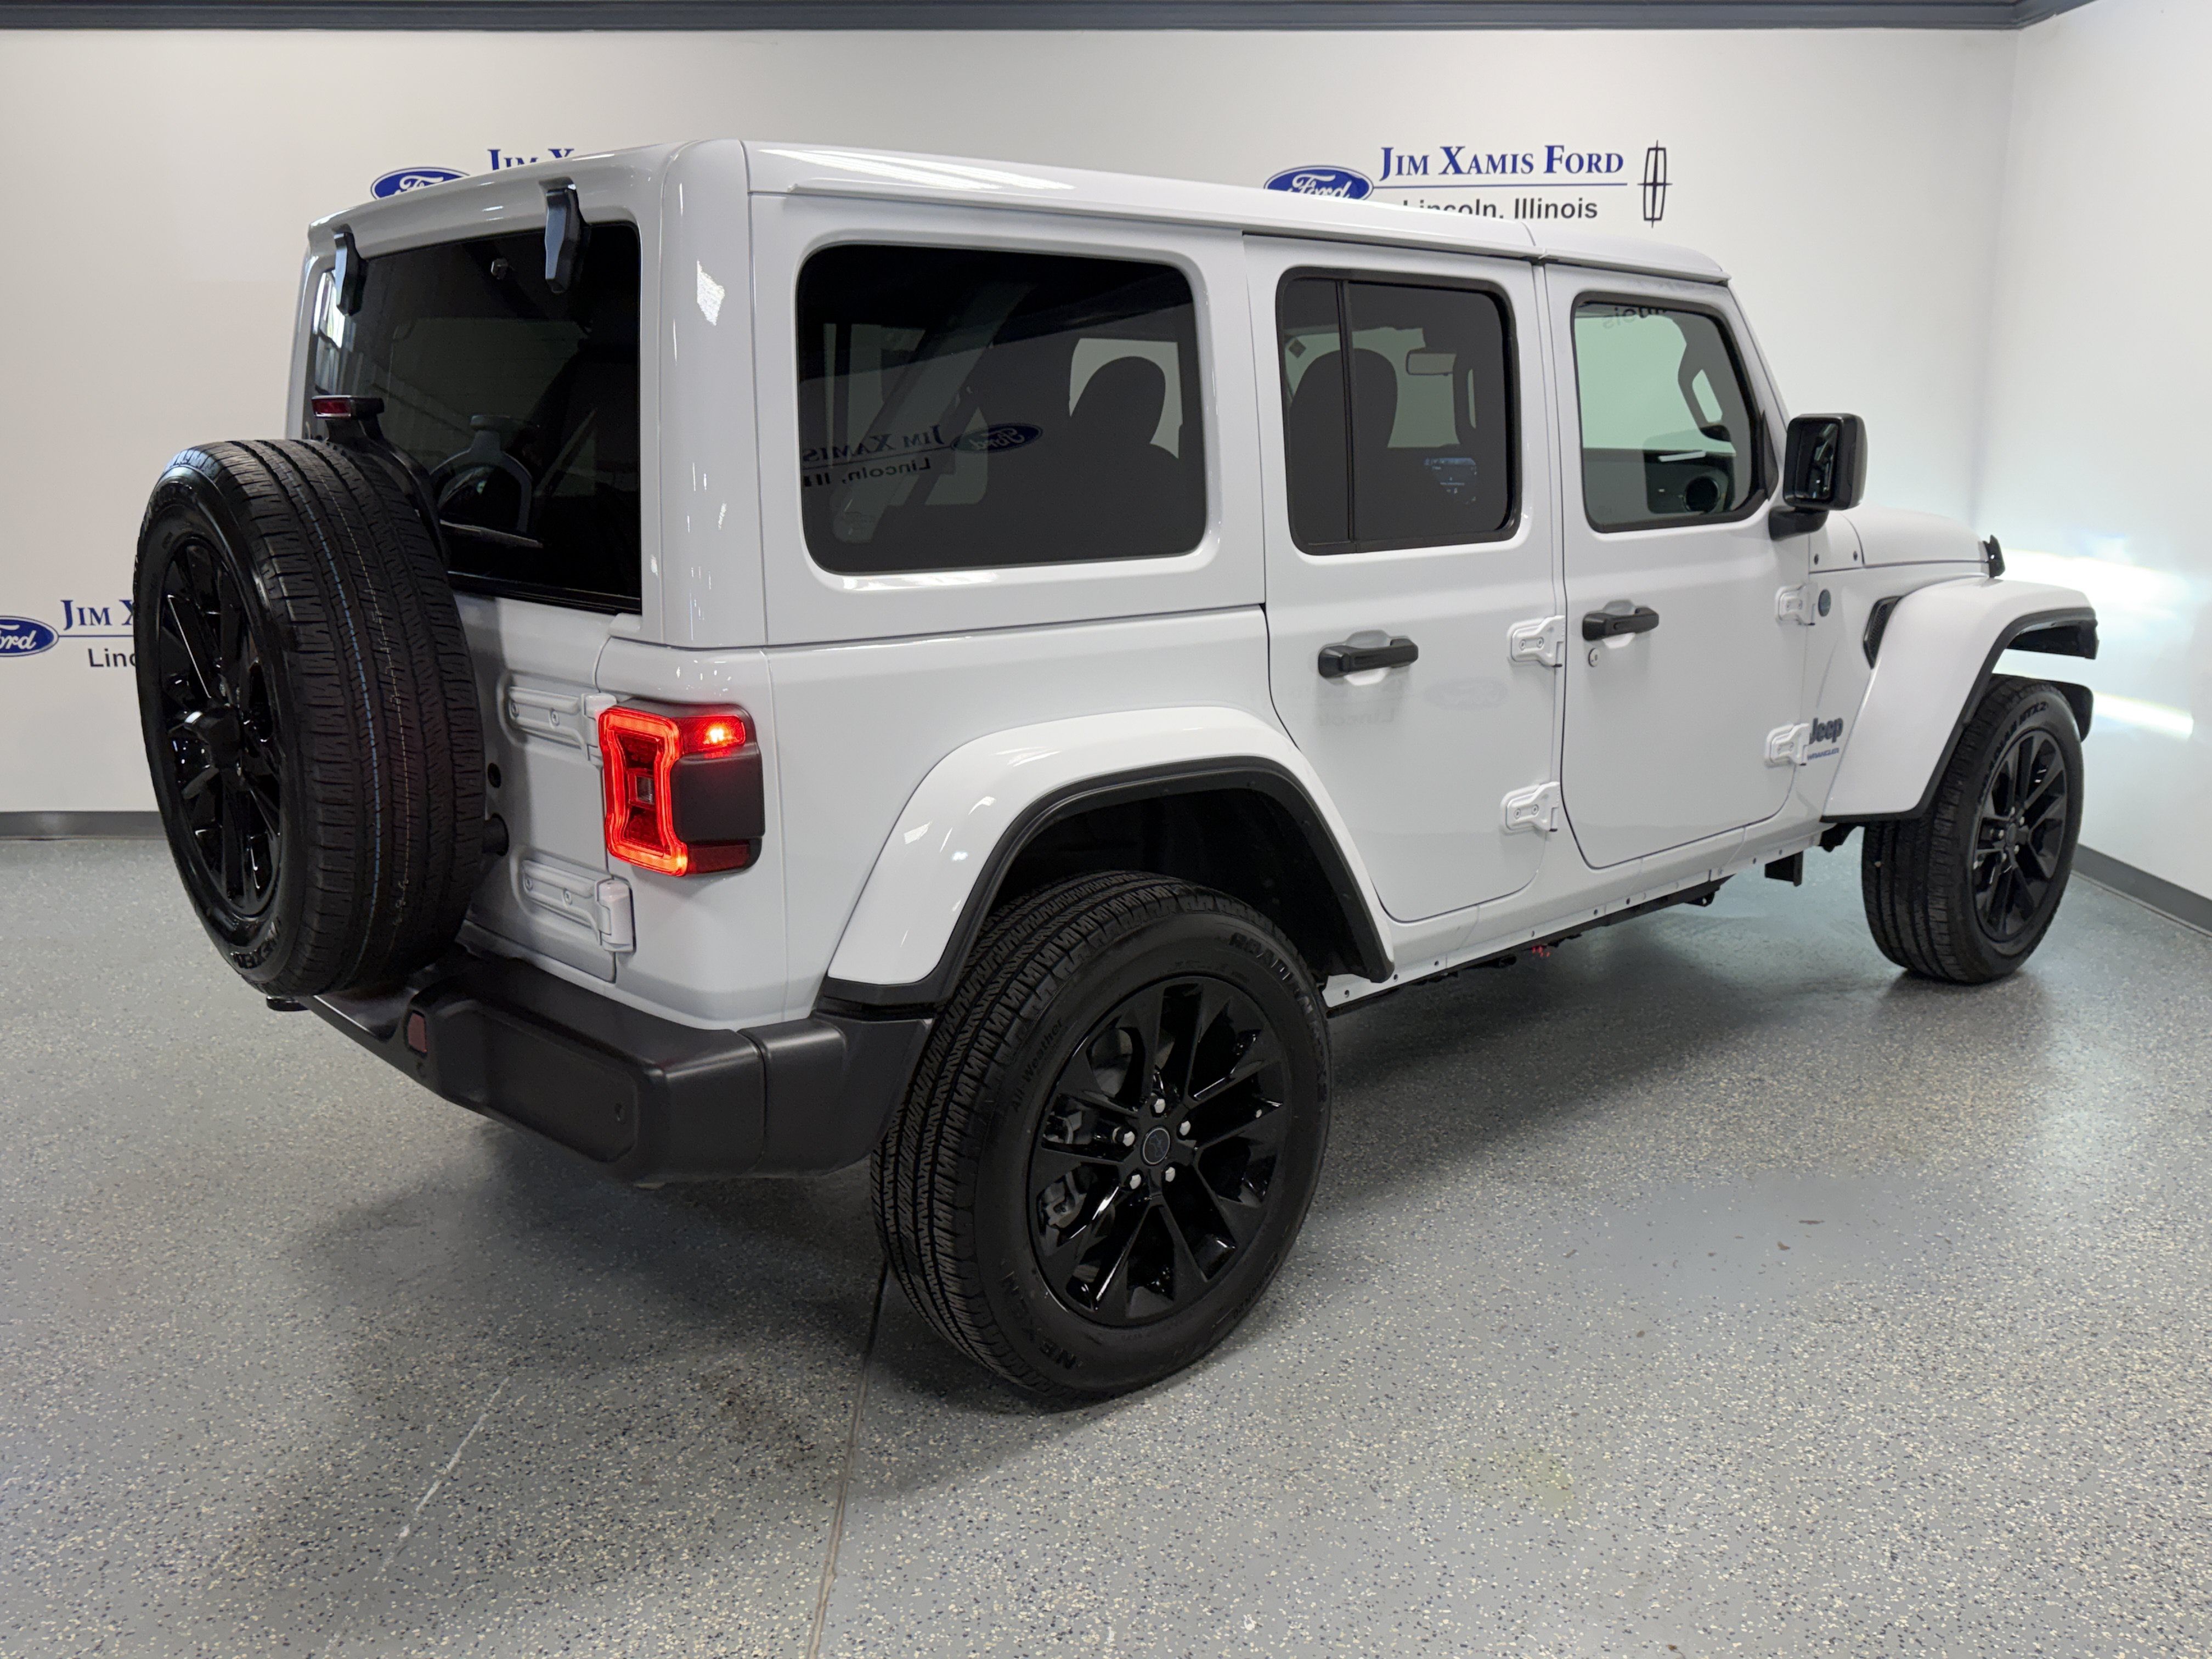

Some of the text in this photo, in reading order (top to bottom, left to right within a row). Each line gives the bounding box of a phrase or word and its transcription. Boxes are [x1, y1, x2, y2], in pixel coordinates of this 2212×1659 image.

[1543, 145, 1623, 174] FORD
[1514, 198, 1598, 219] Illinois
[1809, 717, 1844, 745] Jeep
